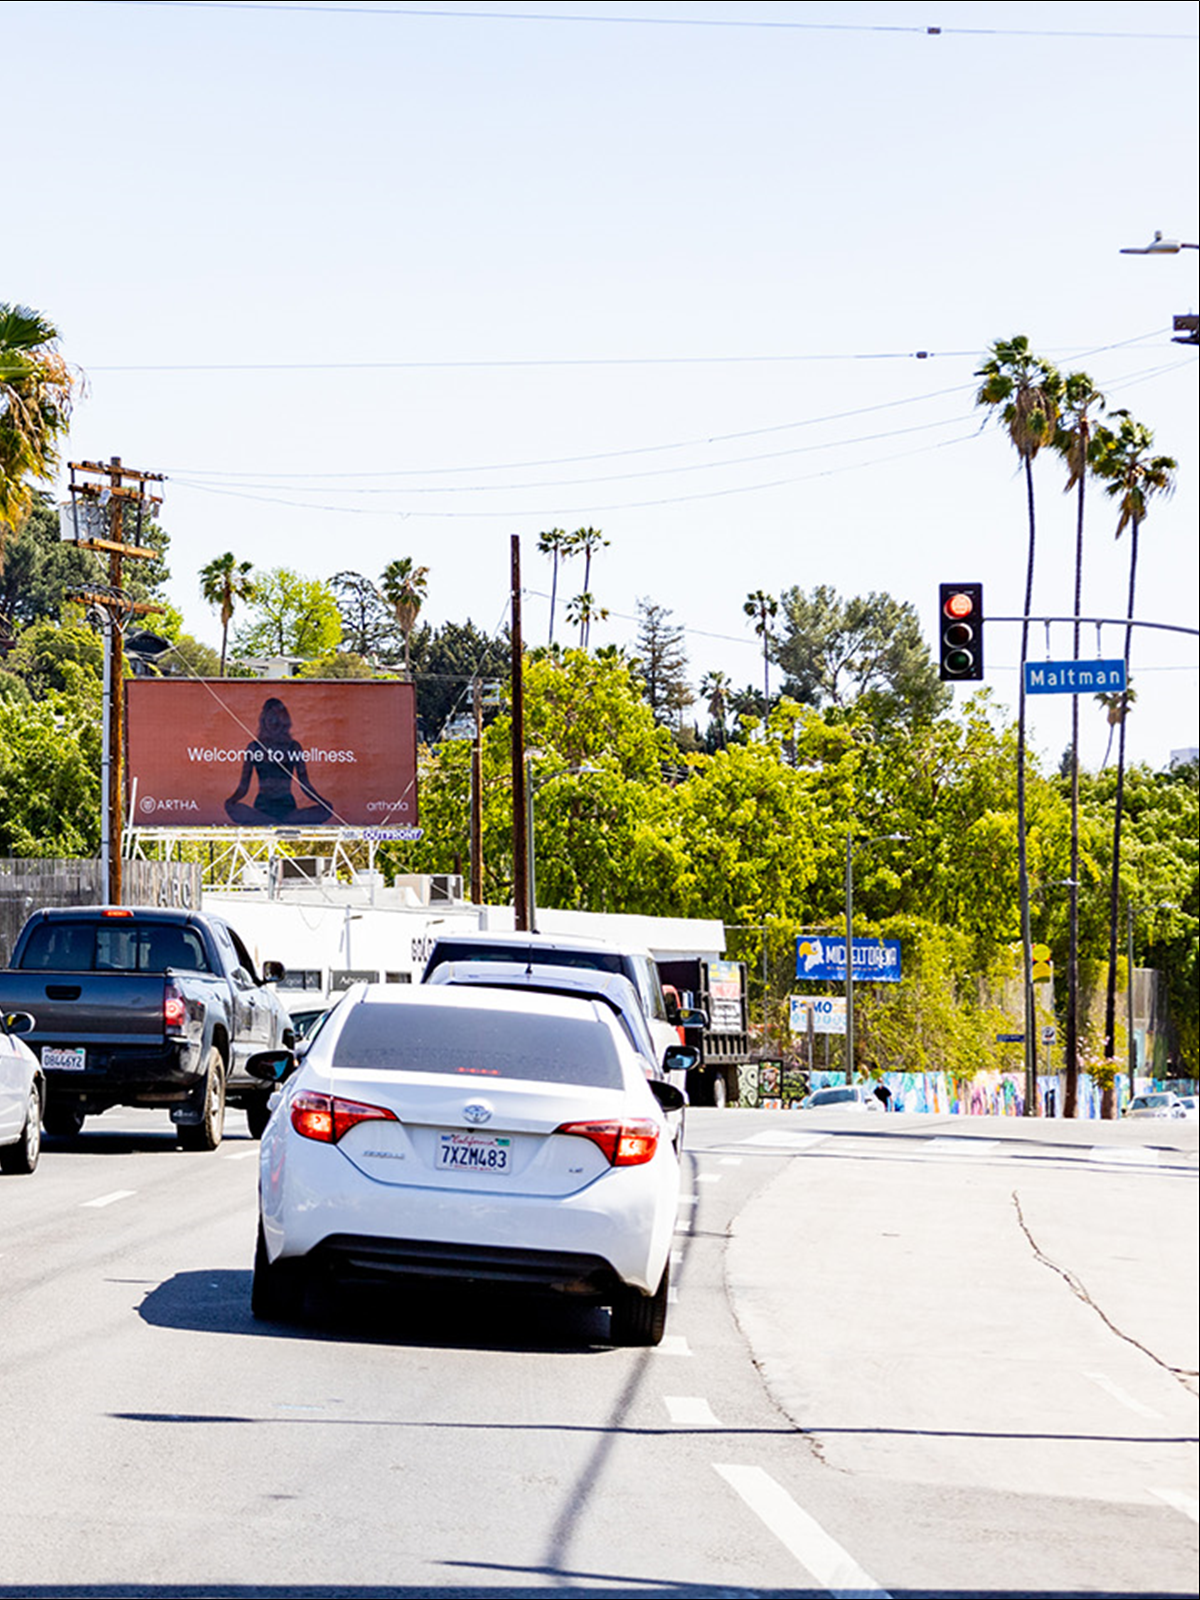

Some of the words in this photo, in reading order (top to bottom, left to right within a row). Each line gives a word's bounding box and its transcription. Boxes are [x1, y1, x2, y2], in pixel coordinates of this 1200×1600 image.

[1030, 669, 1120, 686] Maltman
[187, 748, 264, 762] Welcome
[267, 749, 284, 762] to
[287, 748, 357, 763] wellness.
[365, 830, 421, 840] OUTFRONT
[441, 1145, 507, 1169] 7XZM483
